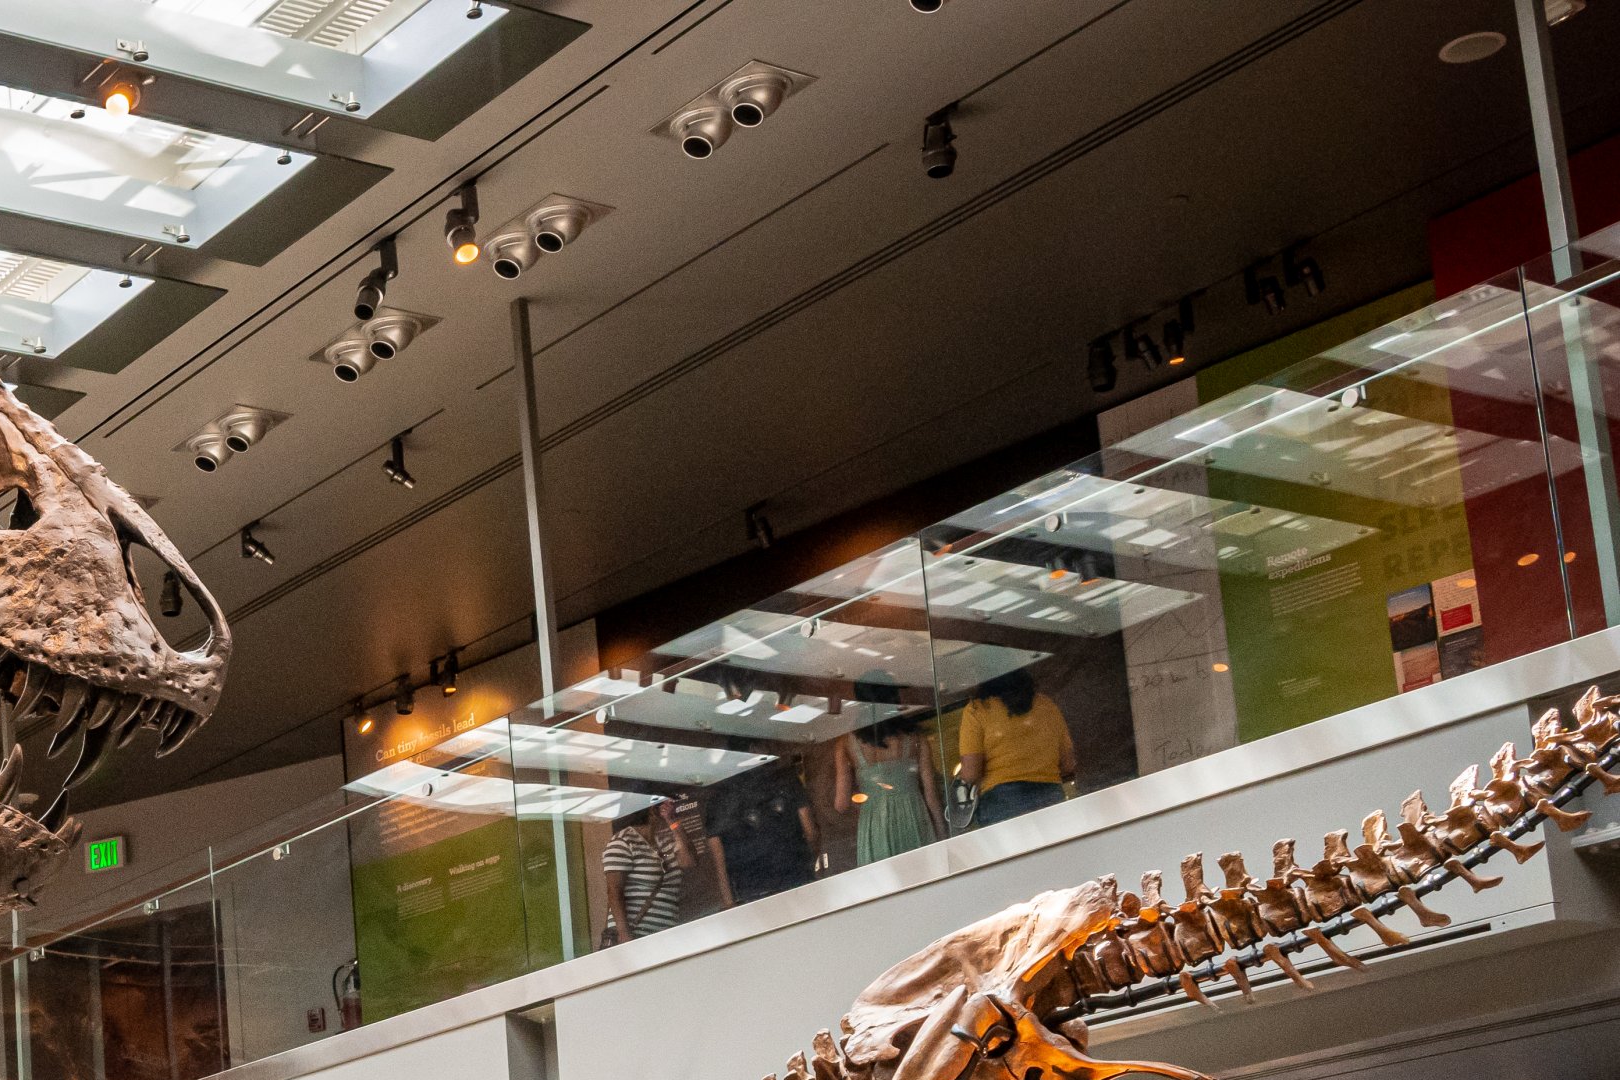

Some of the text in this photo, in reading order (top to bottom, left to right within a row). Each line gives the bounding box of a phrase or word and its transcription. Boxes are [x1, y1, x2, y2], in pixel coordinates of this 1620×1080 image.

[1267, 547, 1308, 567] Remote
[1269, 554, 1331, 580] expeditions
[675, 801, 698, 813] stions
[89, 839, 118, 870] EXIT
